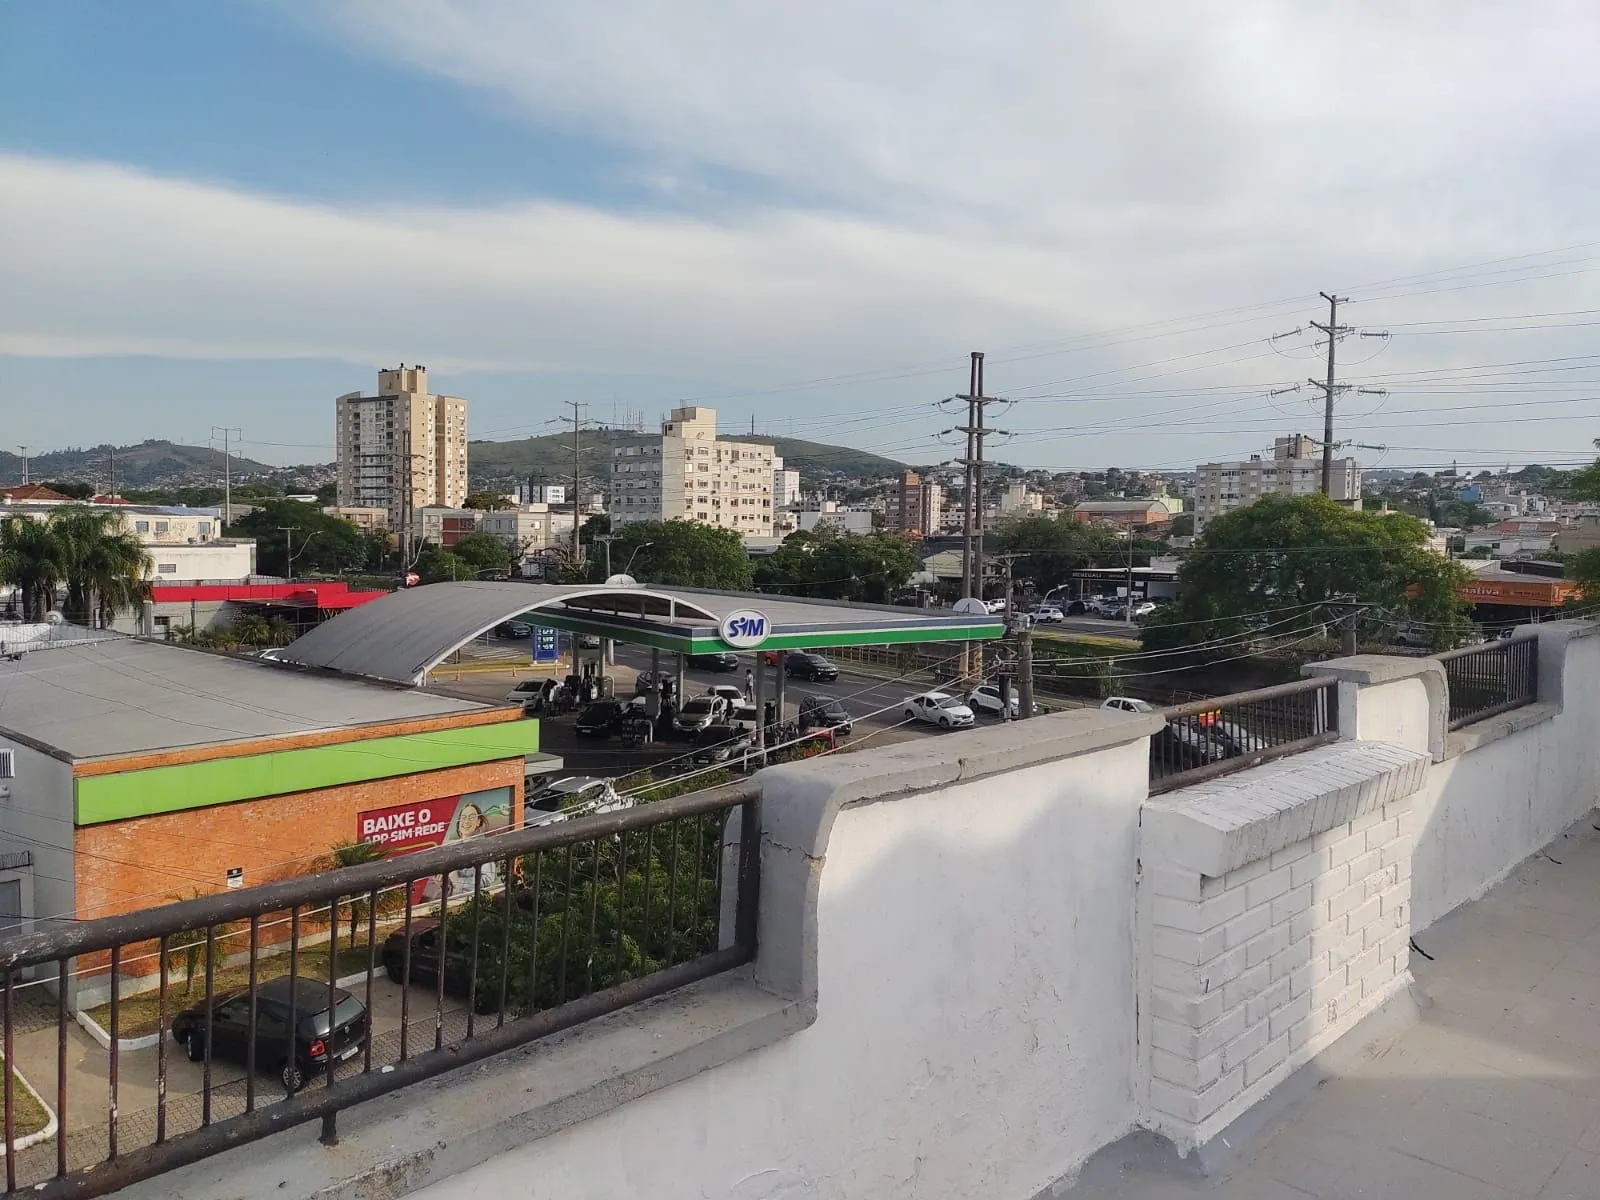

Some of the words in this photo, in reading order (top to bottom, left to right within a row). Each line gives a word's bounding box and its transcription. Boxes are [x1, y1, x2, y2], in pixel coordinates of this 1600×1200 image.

[729, 617, 764, 638] SIM
[363, 811, 415, 835] BAIXE
[418, 808, 431, 823] O
[364, 832, 389, 845] APP
[390, 827, 413, 843] SIM
[414, 821, 445, 837] REDE
